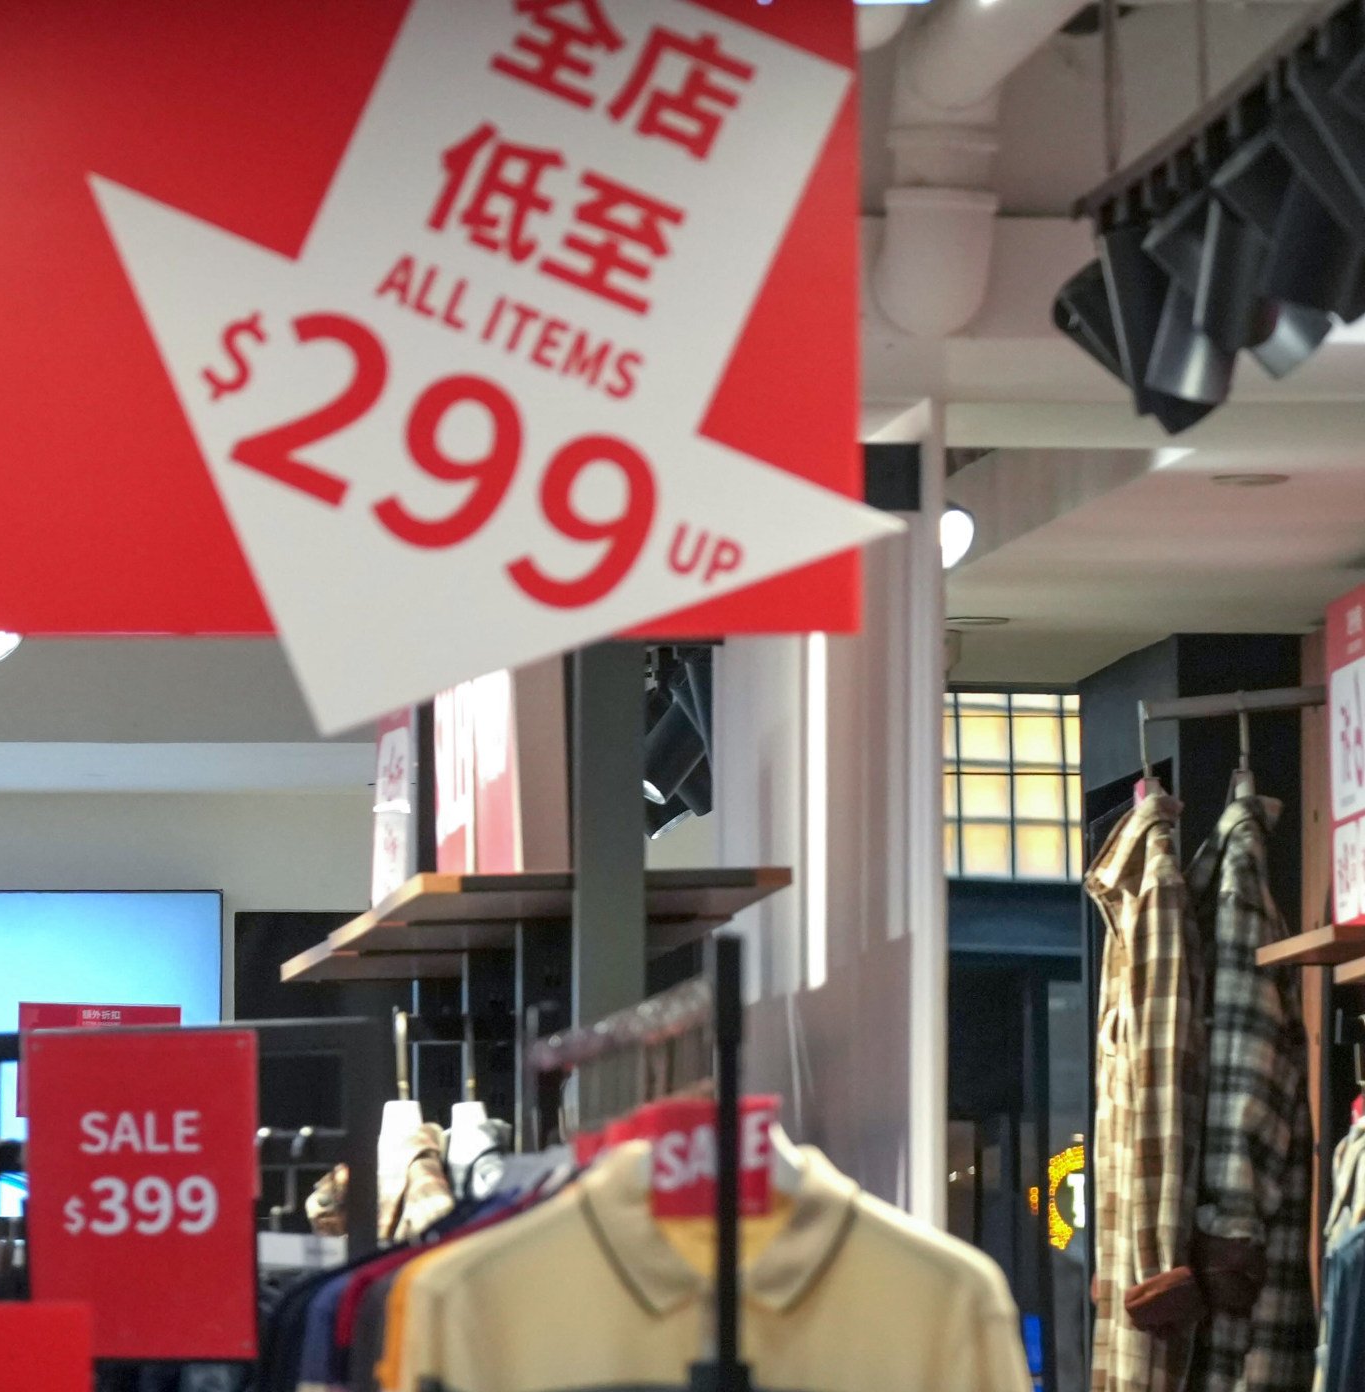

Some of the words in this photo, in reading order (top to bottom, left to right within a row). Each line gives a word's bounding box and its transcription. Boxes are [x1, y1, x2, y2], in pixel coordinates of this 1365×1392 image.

[488, 0, 757, 161] 全店
[425, 121, 687, 318] 低至
[375, 254, 470, 332] ALL
[479, 297, 645, 402] ITEMS
[200, 310, 660, 612] $299
[667, 522, 745, 584] UP
[80, 1110, 202, 1155] SALE
[654, 1109, 770, 1192] SAE
[64, 1175, 218, 1236] $399
